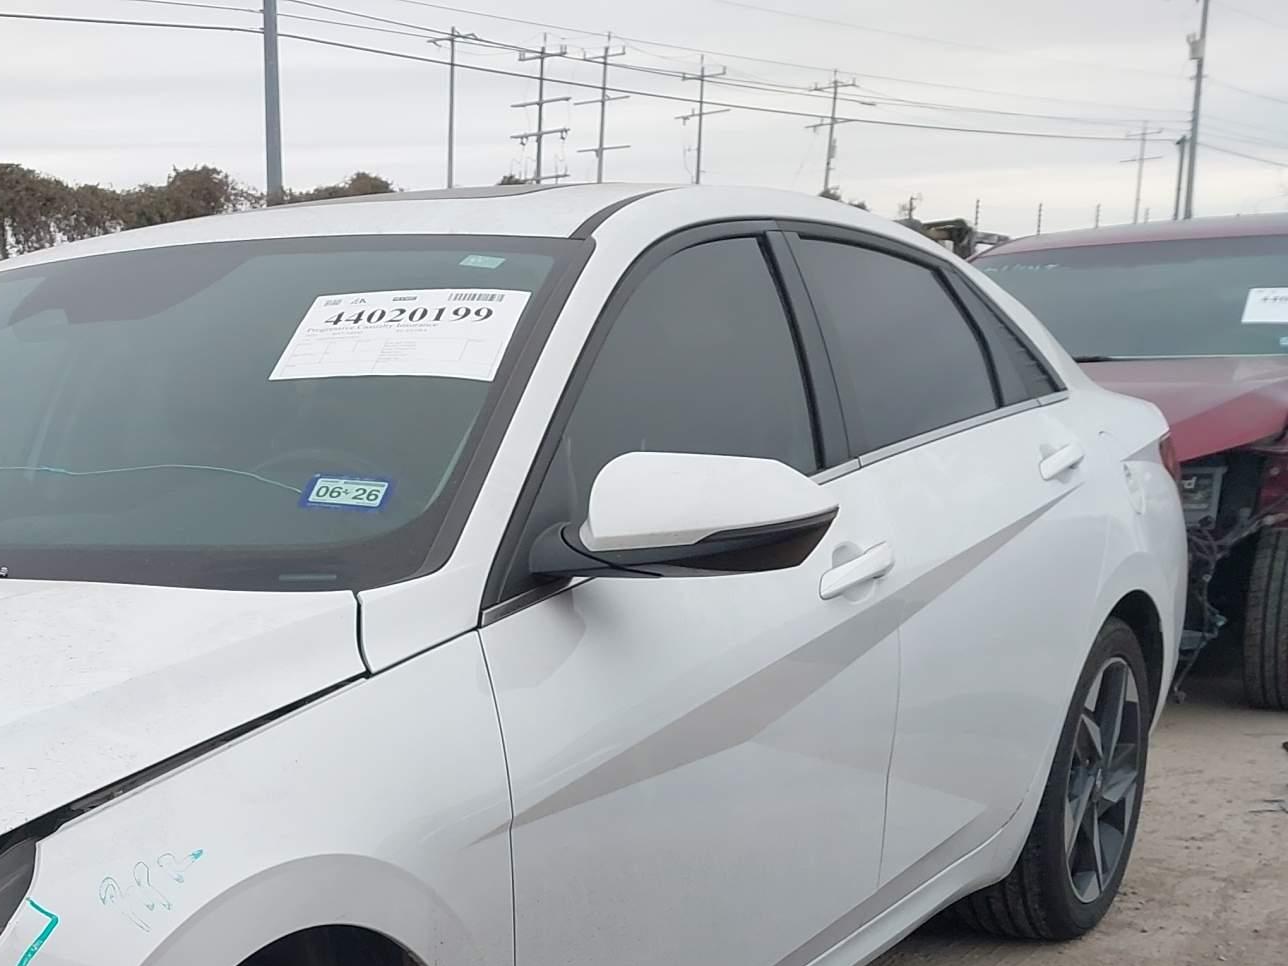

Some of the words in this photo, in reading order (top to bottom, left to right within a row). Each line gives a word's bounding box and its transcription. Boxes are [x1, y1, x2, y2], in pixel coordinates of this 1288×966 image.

[324, 306, 494, 325] 44020199
[315, 485, 343, 499] 06
[351, 487, 381, 502] 26
